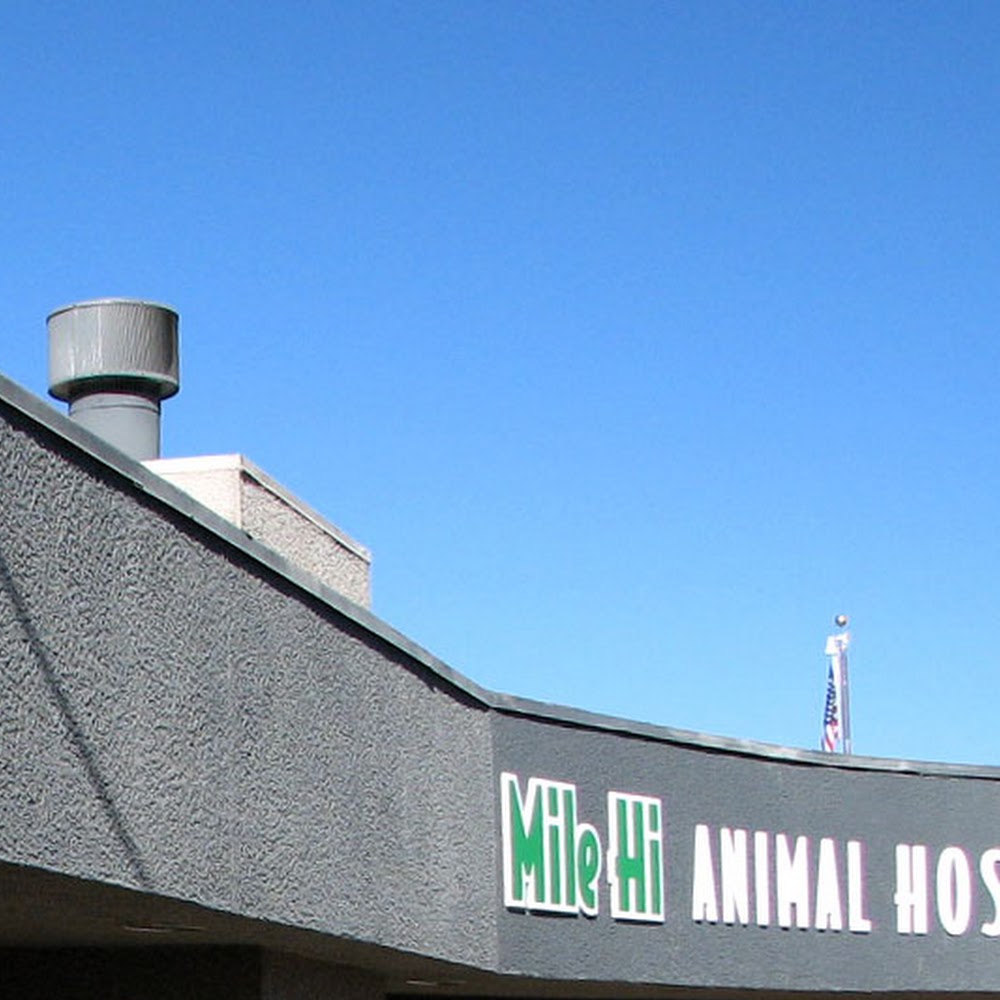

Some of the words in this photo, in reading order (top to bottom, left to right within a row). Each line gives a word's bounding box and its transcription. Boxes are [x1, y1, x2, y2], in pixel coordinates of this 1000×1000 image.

[501, 772, 602, 917] Mile
[607, 791, 665, 922] Hi
[692, 824, 872, 932] ANIMAL
[893, 843, 1000, 937] HOS
